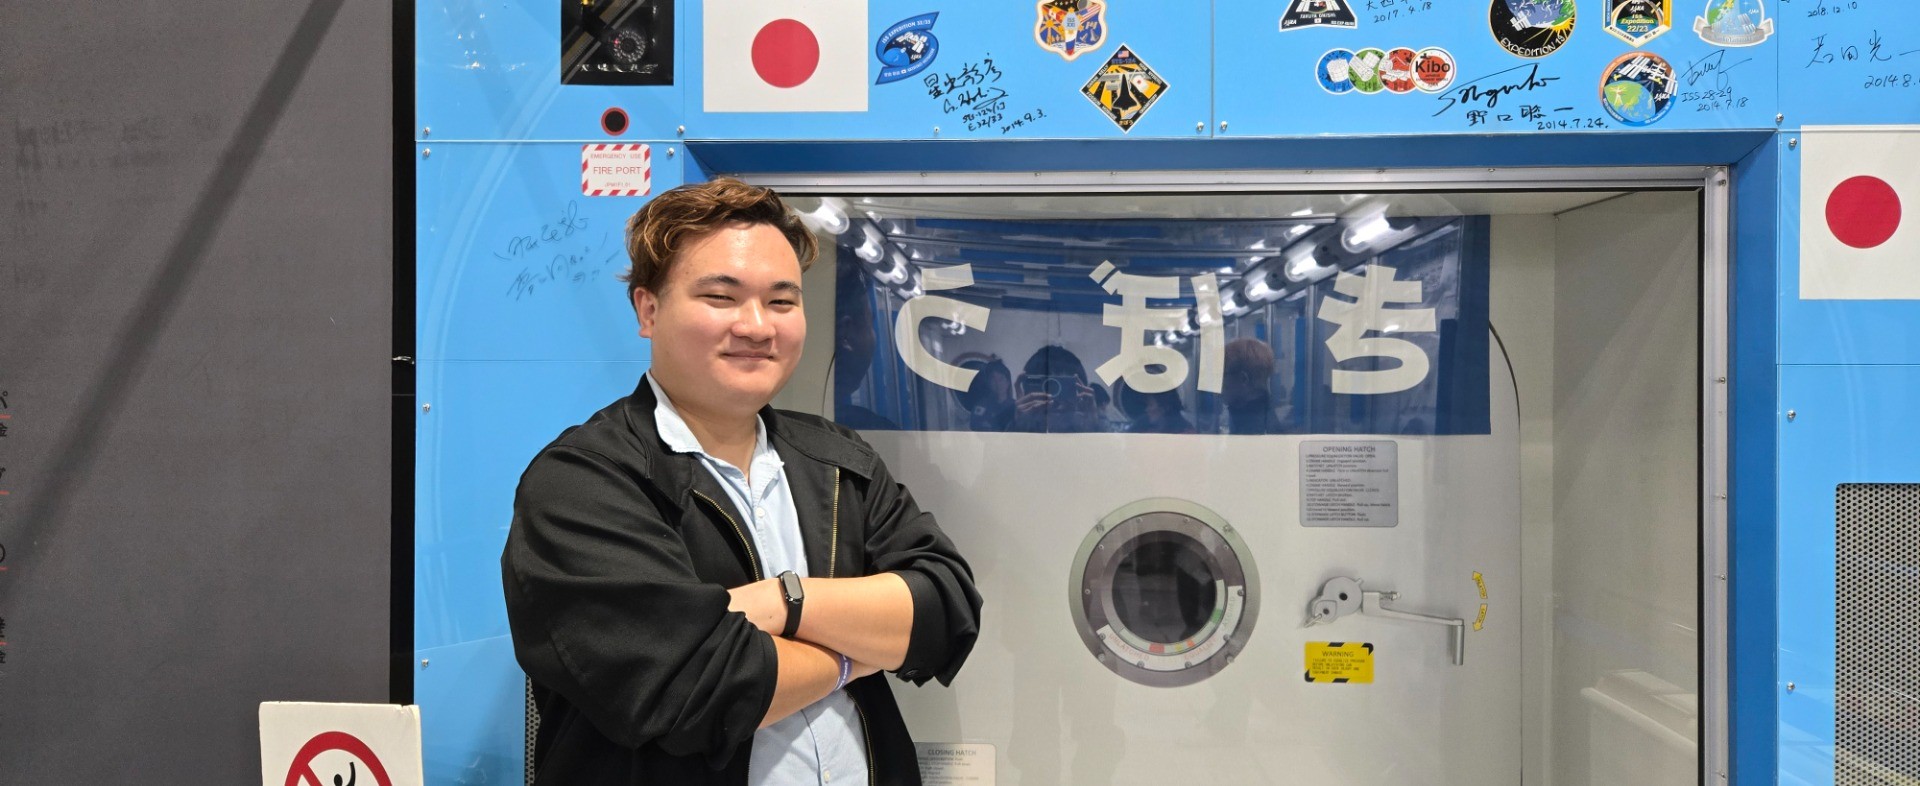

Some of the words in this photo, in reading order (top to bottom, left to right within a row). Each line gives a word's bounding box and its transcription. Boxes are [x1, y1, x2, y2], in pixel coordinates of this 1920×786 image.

[1500, 36, 1556, 57] EXPEDITION
[1415, 60, 1450, 73] Kibo
[1864, 74, 1920, 89] 2014.8.
[593, 166, 613, 174] FIRE
[615, 166, 642, 174] PORT
